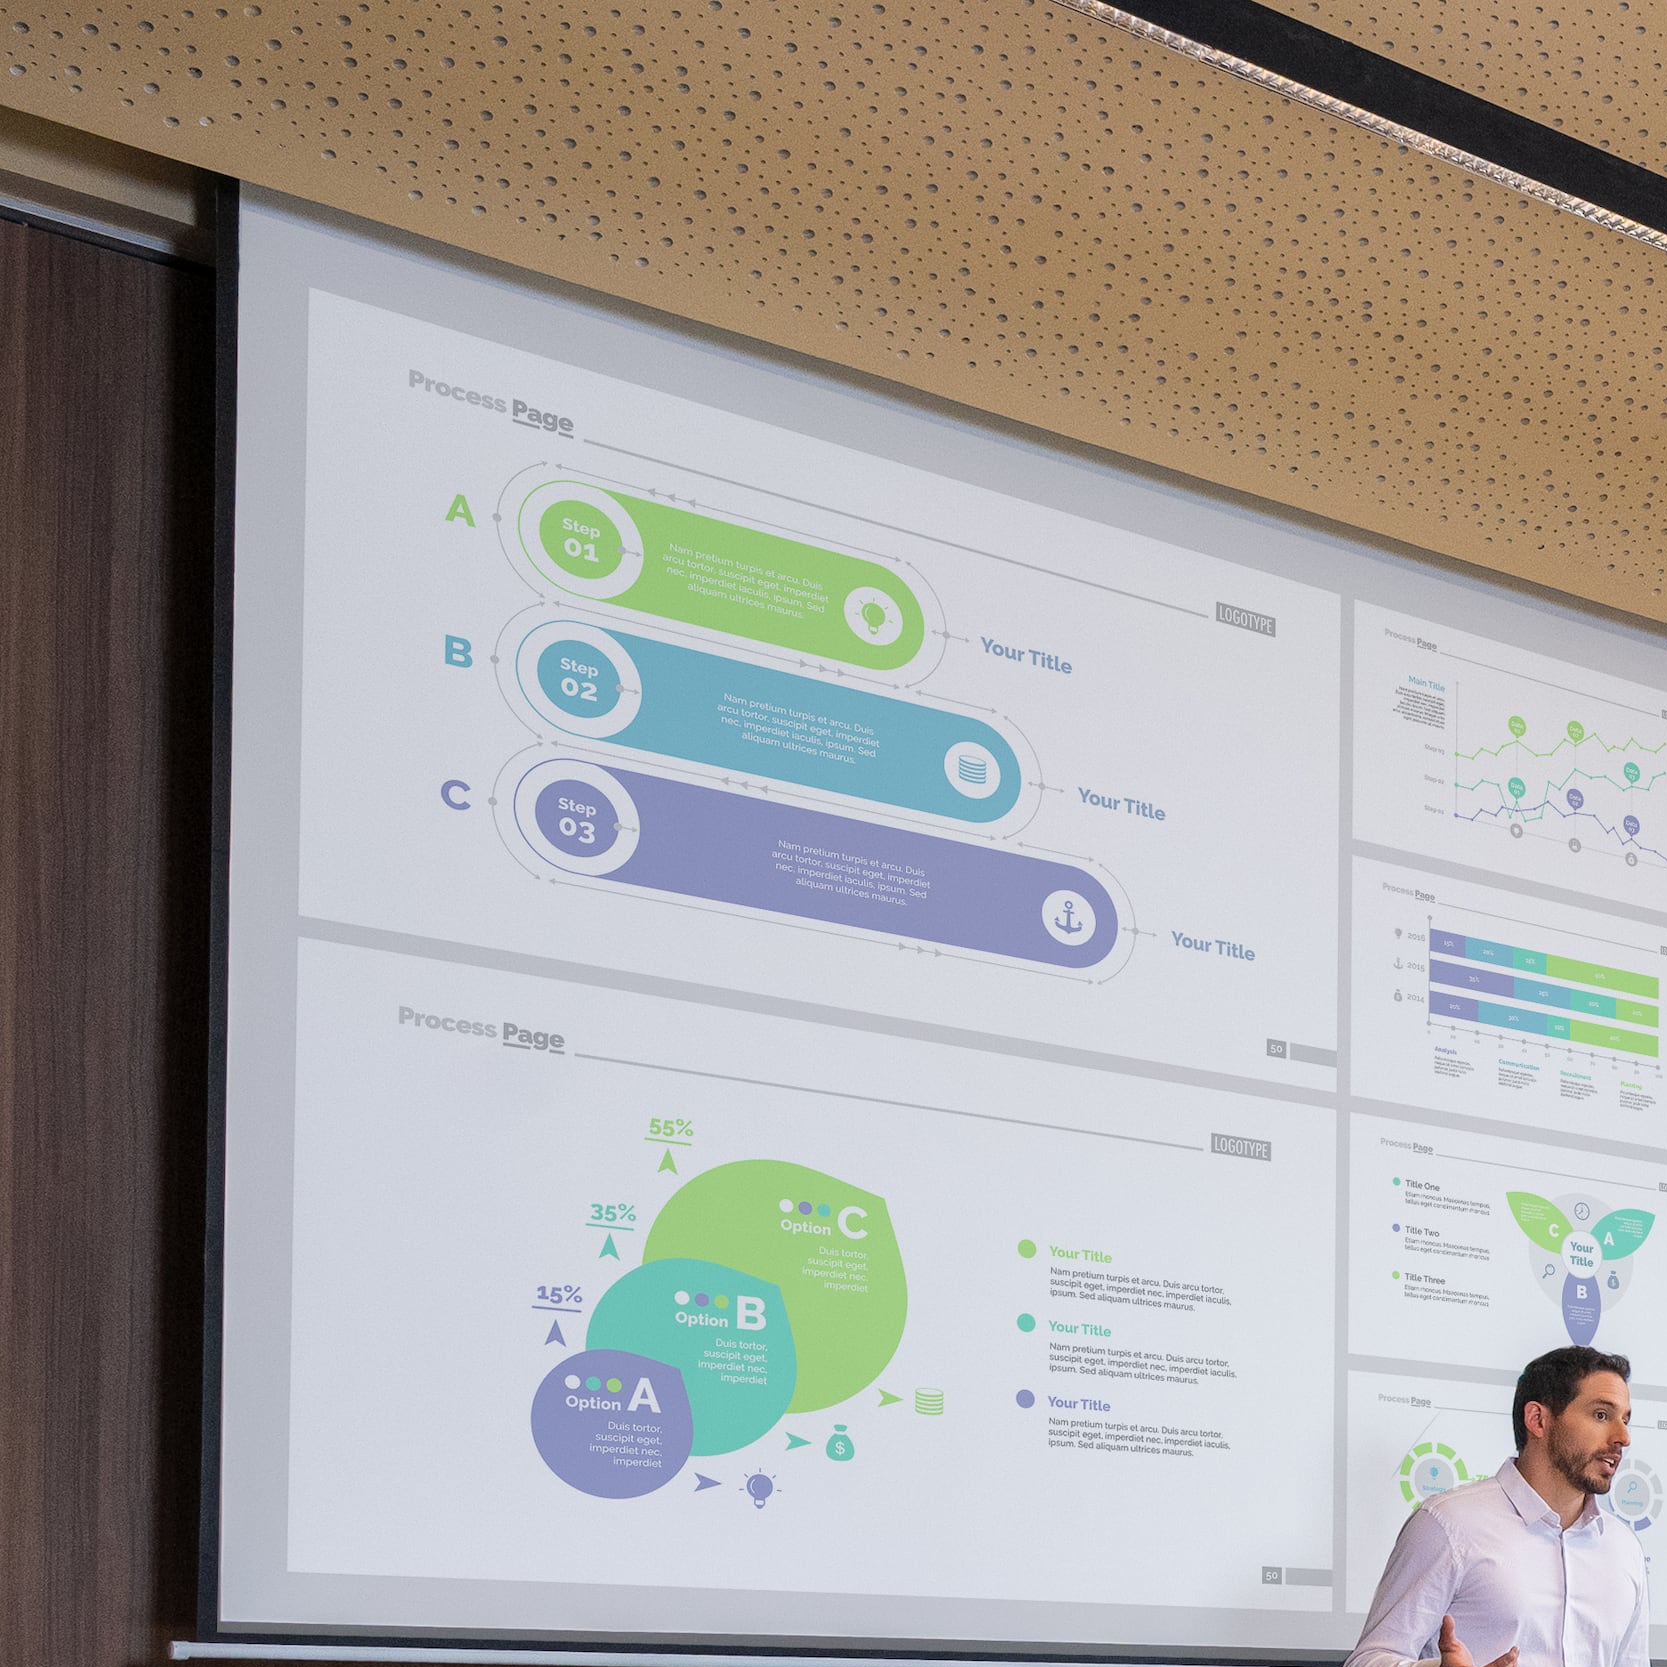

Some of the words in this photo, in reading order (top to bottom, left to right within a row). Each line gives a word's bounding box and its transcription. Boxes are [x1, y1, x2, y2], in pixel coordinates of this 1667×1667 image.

[409, 369, 507, 413] Process
[512, 398, 575, 434] Page
[445, 494, 476, 528] A
[562, 518, 600, 539] Step
[564, 538, 599, 562] 01
[1219, 605, 1273, 634] LOGOTYPE
[1385, 628, 1416, 644] Process
[1417, 638, 1437, 651] Page
[445, 634, 473, 668] B
[981, 636, 1025, 662] Your
[1029, 650, 1073, 674] Title
[560, 657, 598, 678] Step
[561, 678, 597, 701] 02
[1408, 675, 1427, 687] Main
[1428, 681, 1446, 693] Title
[441, 780, 471, 811] C
[1078, 787, 1120, 811] Your
[1124, 799, 1166, 821] Title
[558, 797, 597, 818] Step
[559, 817, 596, 844] 03
[1382, 883, 1414, 896] Process
[1415, 890, 1436, 902] Page
[1171, 931, 1212, 952] Your
[1215, 940, 1256, 961] Title
[1407, 962, 1425, 973] 2015
[1407, 993, 1425, 1003] 2014
[399, 1006, 497, 1038] Process
[503, 1022, 565, 1051] Page
[1270, 1044, 1283, 1054] 50
[649, 1118, 694, 1137] 55%
[1215, 1135, 1268, 1159] LOGOTYPE
[1380, 1137, 1412, 1150] Process
[1413, 1142, 1434, 1154] Page
[1405, 1179, 1423, 1190] Title
[1424, 1182, 1440, 1192] One
[591, 1203, 637, 1222] 35%
[781, 1219, 831, 1235] Option
[838, 1206, 868, 1240] C
[1405, 1225, 1422, 1235] Title
[1424, 1228, 1440, 1238] Two
[1548, 1223, 1560, 1238] C
[1604, 1231, 1615, 1246] A
[1050, 1246, 1080, 1260] Your
[1082, 1249, 1112, 1263] Title
[1570, 1241, 1594, 1254] Your
[1570, 1255, 1594, 1268] Title
[1404, 1272, 1422, 1282] Title
[1423, 1275, 1446, 1285] Three
[537, 1284, 583, 1304] 15%
[1576, 1284, 1588, 1299] B
[675, 1311, 728, 1327] Option
[737, 1295, 767, 1331] B
[1048, 1320, 1079, 1334] Your
[1081, 1323, 1111, 1337] Title
[716, 1338, 736, 1348] Duis
[704, 1350, 741, 1361] suscipit
[698, 1360, 745, 1372] imperdiet
[720, 1372, 767, 1384] imperdiet
[566, 1395, 621, 1411] Option
[627, 1377, 661, 1413] A
[1048, 1395, 1078, 1409] Your
[1080, 1399, 1111, 1412] Title
[1378, 1393, 1410, 1404] Process
[1411, 1397, 1432, 1407] Page
[608, 1421, 630, 1431] Duis
[595, 1433, 634, 1443] suscipit
[589, 1443, 639, 1454] imperdiet
[613, 1456, 662, 1468] imperdiet
[1266, 1571, 1278, 1580] 50
